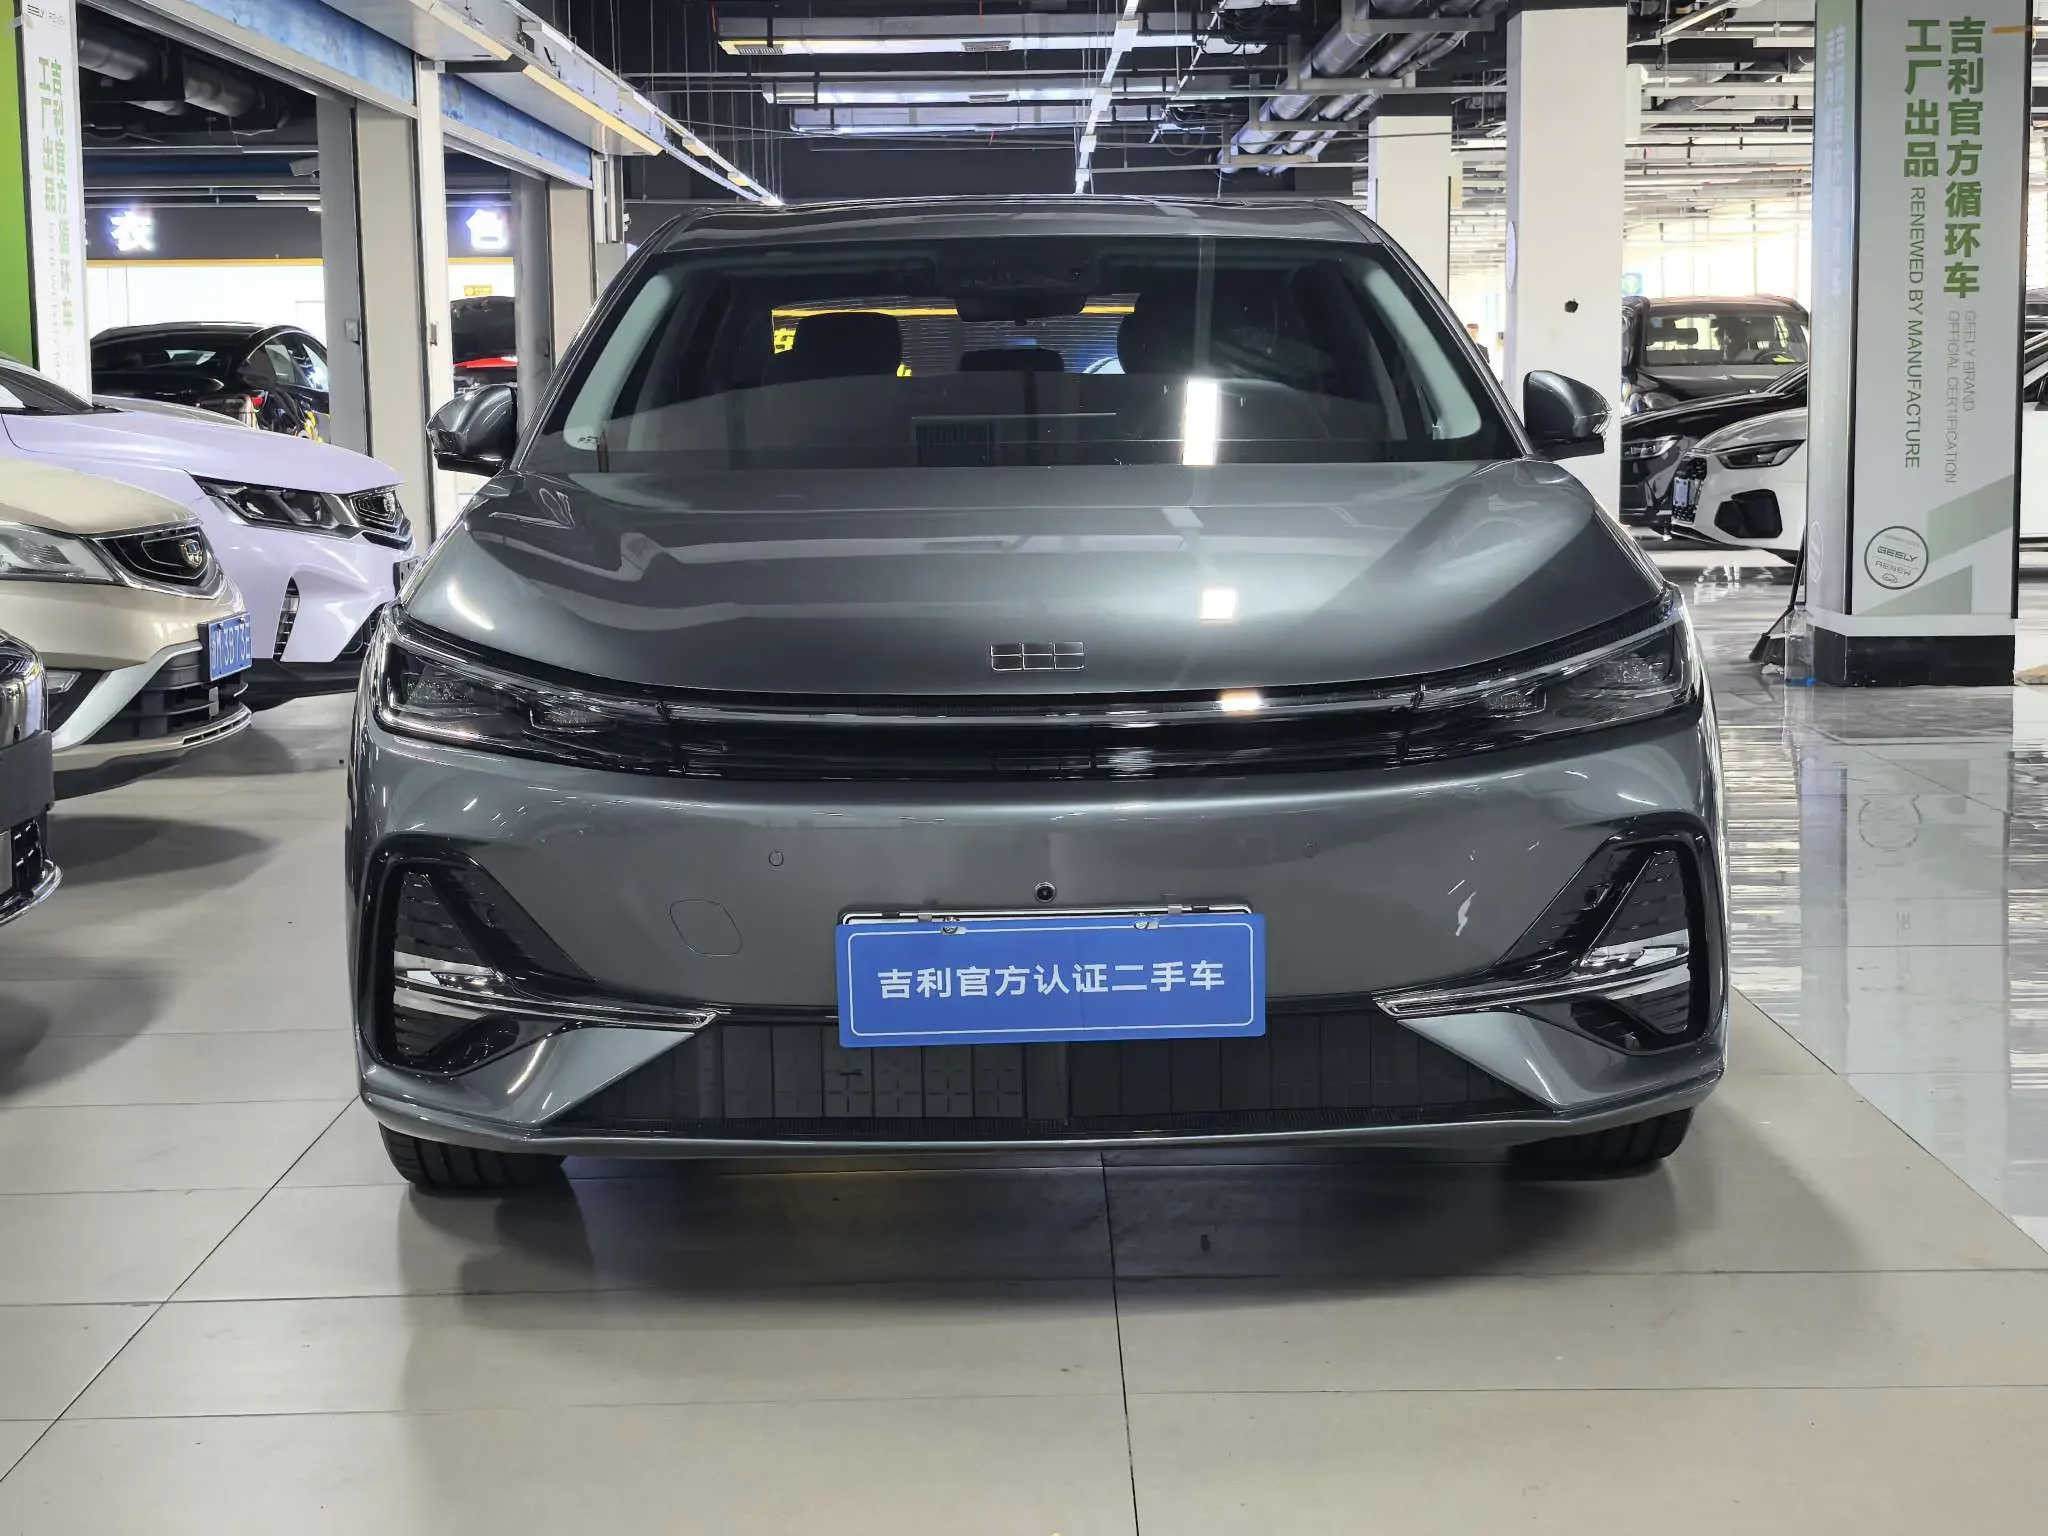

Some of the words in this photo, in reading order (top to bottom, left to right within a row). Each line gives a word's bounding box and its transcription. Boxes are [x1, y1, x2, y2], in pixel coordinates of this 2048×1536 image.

[1904, 19, 1942, 178] 工厂出品
[1943, 16, 1986, 299] 吉利官方循环车
[1909, 187, 1926, 284] RENEWED
[1908, 289, 1924, 315] BY
[1945, 311, 1960, 373] OFFICIAL
[1963, 311, 1977, 356] GEELY
[1905, 320, 1923, 468] MANUFACTURE
[1962, 361, 1976, 412] BRAND
[1944, 377, 1959, 484] CERTIFICATION
[1877, 546, 1918, 563] GEELY
[877, 960, 1226, 1000] 吉利官方认证二手车
